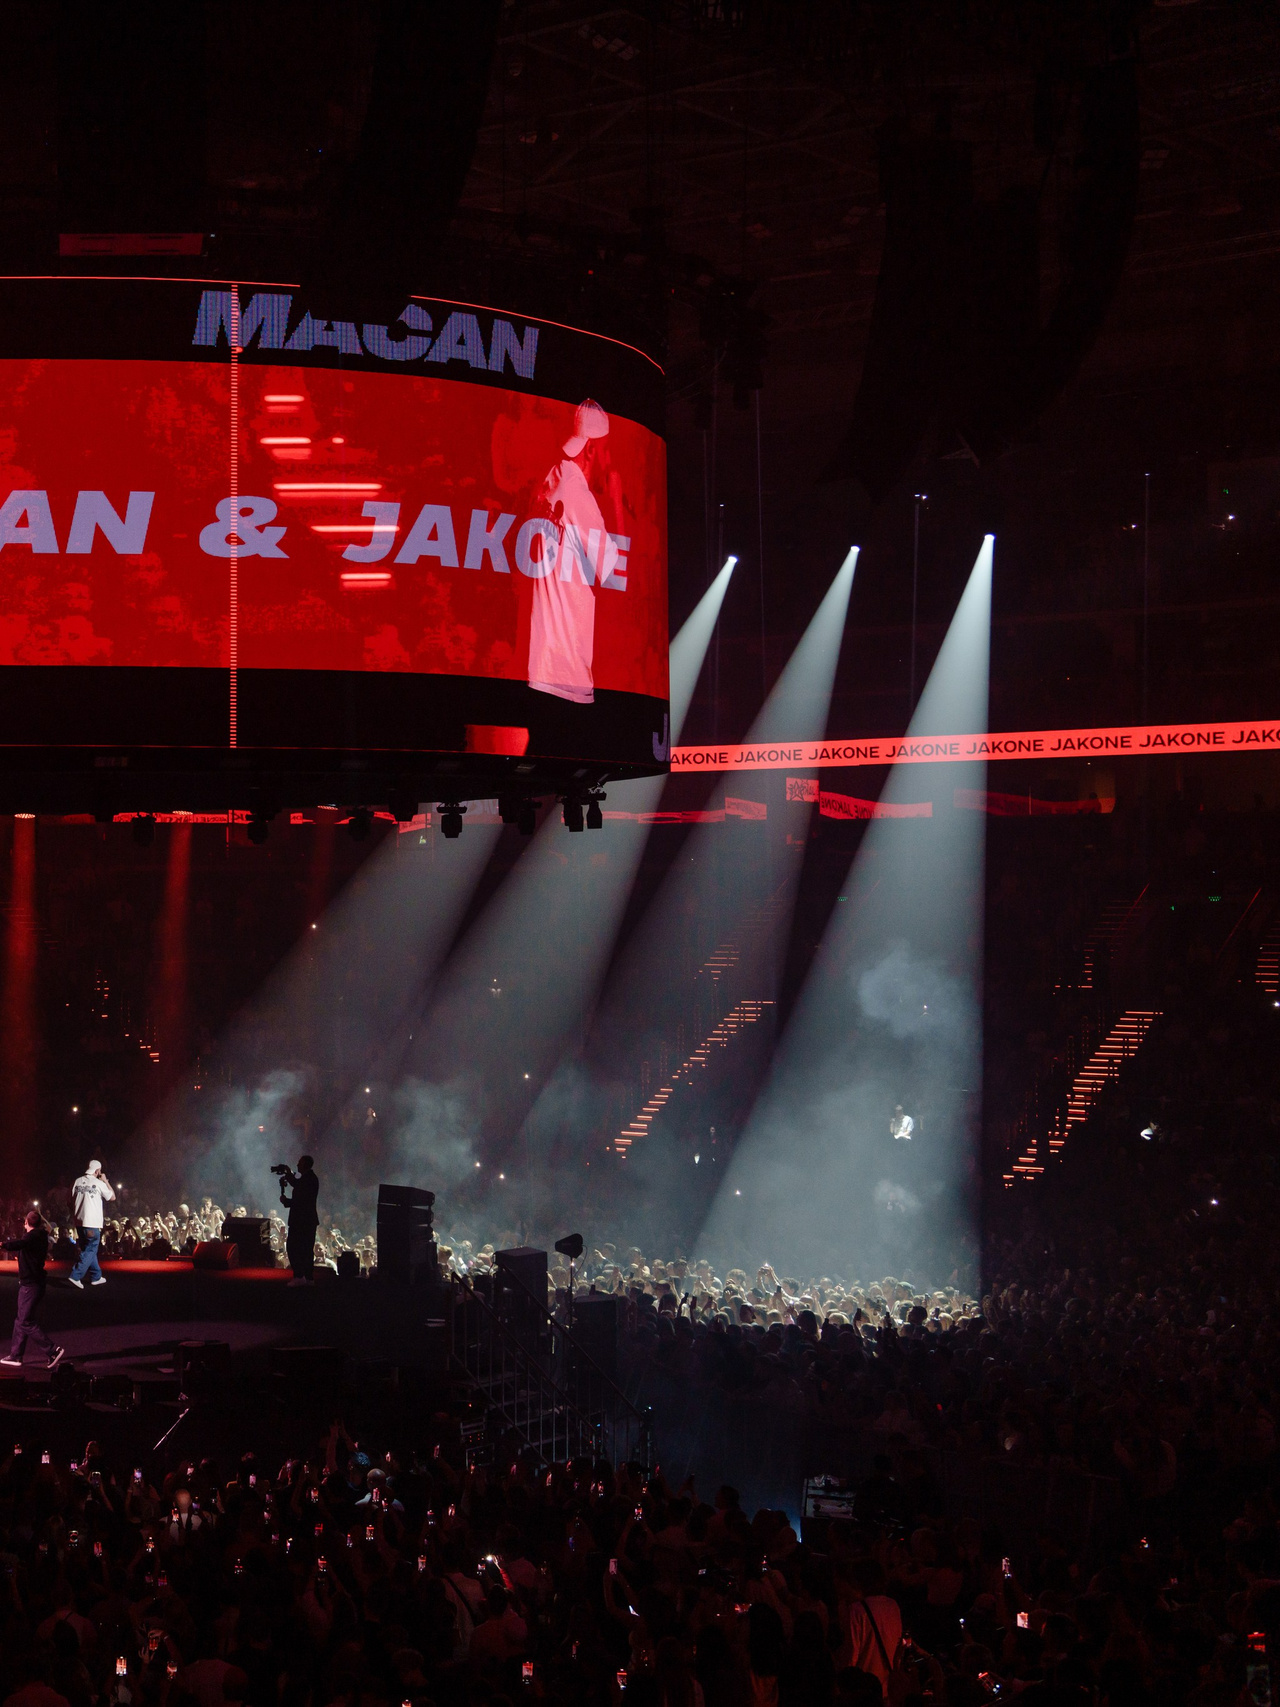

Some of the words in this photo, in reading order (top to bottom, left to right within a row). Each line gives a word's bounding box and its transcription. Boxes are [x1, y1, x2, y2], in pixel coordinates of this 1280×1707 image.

[199, 495, 290, 559] &
[341, 500, 632, 592] JAKONE
[735, 749, 802, 764] JAKONE
[809, 746, 879, 761] JAKONE
[886, 743, 959, 758] JAKONE
[967, 739, 1043, 755] JAKONE
[1051, 736, 1131, 751] JAKONE
[1139, 732, 1224, 747] JAKONE
